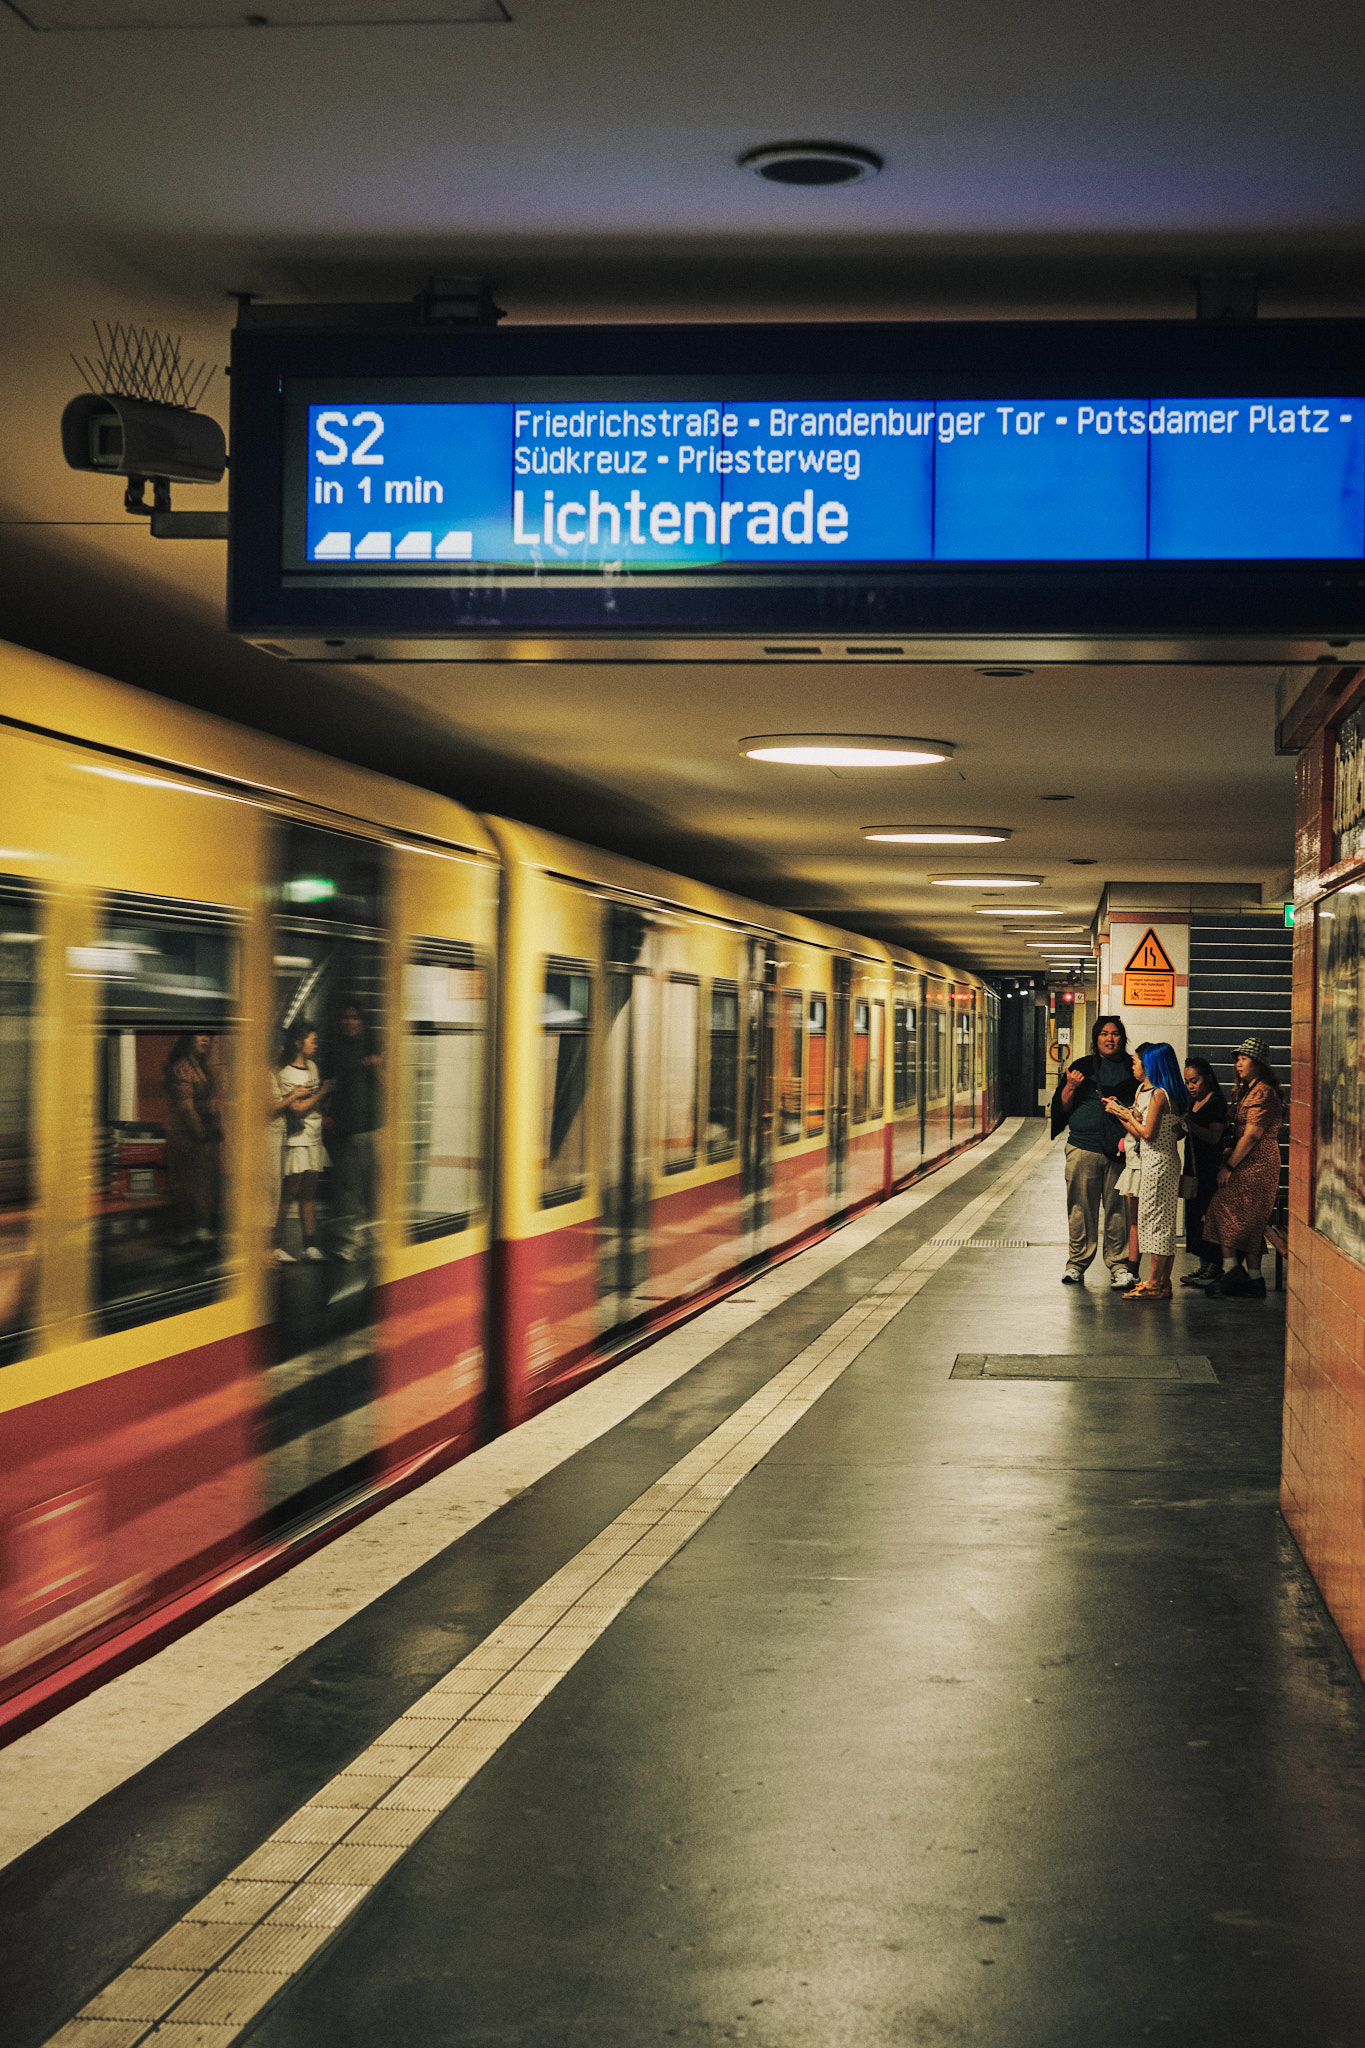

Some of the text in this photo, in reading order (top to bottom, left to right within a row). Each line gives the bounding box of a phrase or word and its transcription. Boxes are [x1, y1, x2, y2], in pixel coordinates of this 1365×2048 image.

[315, 411, 385, 466] S2
[515, 408, 739, 438] Friedrichstraße
[769, 407, 986, 443] Brandenburger
[996, 407, 1046, 435] Tor
[1077, 406, 1239, 435] Potsdamer
[1249, 405, 1330, 434] Platz
[514, 446, 648, 475] Südkreuz
[678, 445, 861, 481] Priesterweg
[314, 475, 444, 504] in 1 min
[513, 488, 849, 546] Lichtenrade
